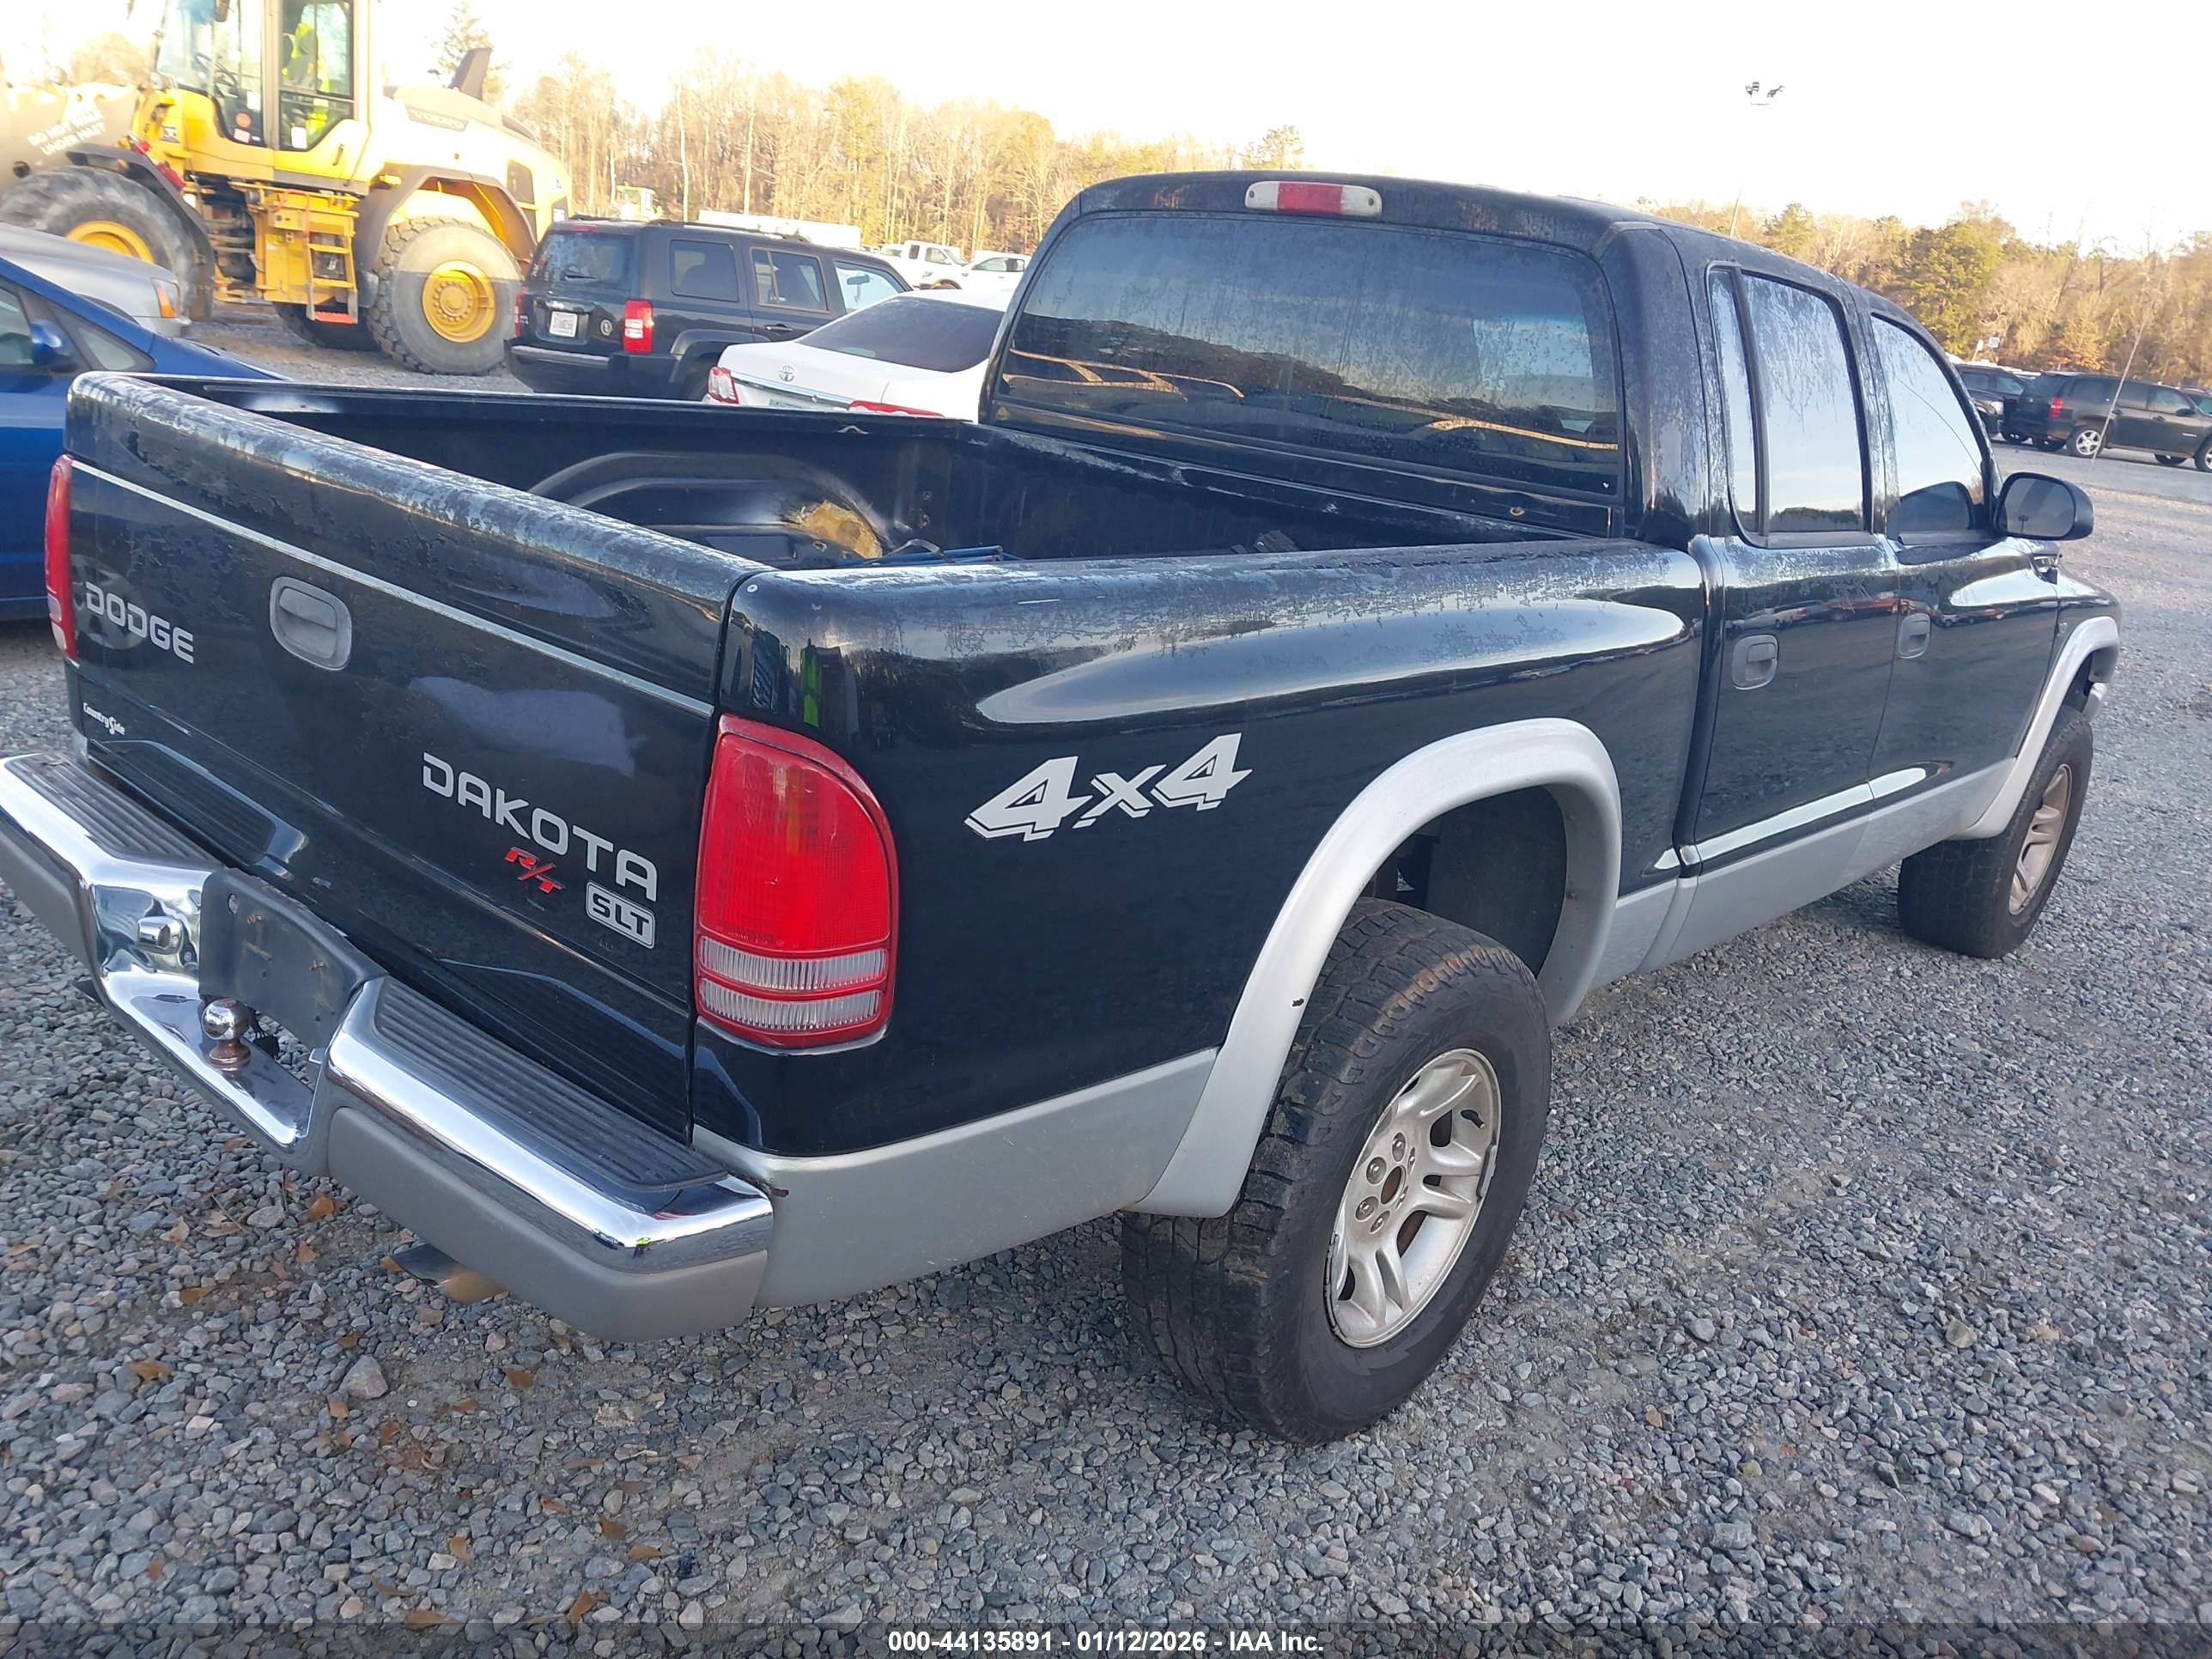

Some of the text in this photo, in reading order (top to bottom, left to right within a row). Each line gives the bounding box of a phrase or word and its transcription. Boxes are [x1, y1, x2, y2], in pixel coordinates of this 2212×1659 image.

[41, 134, 81, 155] UNDER
[86, 581, 194, 664] DODGE
[963, 732, 1253, 842] 4x4
[422, 752, 658, 902] DAKOTA
[504, 847, 566, 893] R/T
[591, 890, 651, 938] SLT
